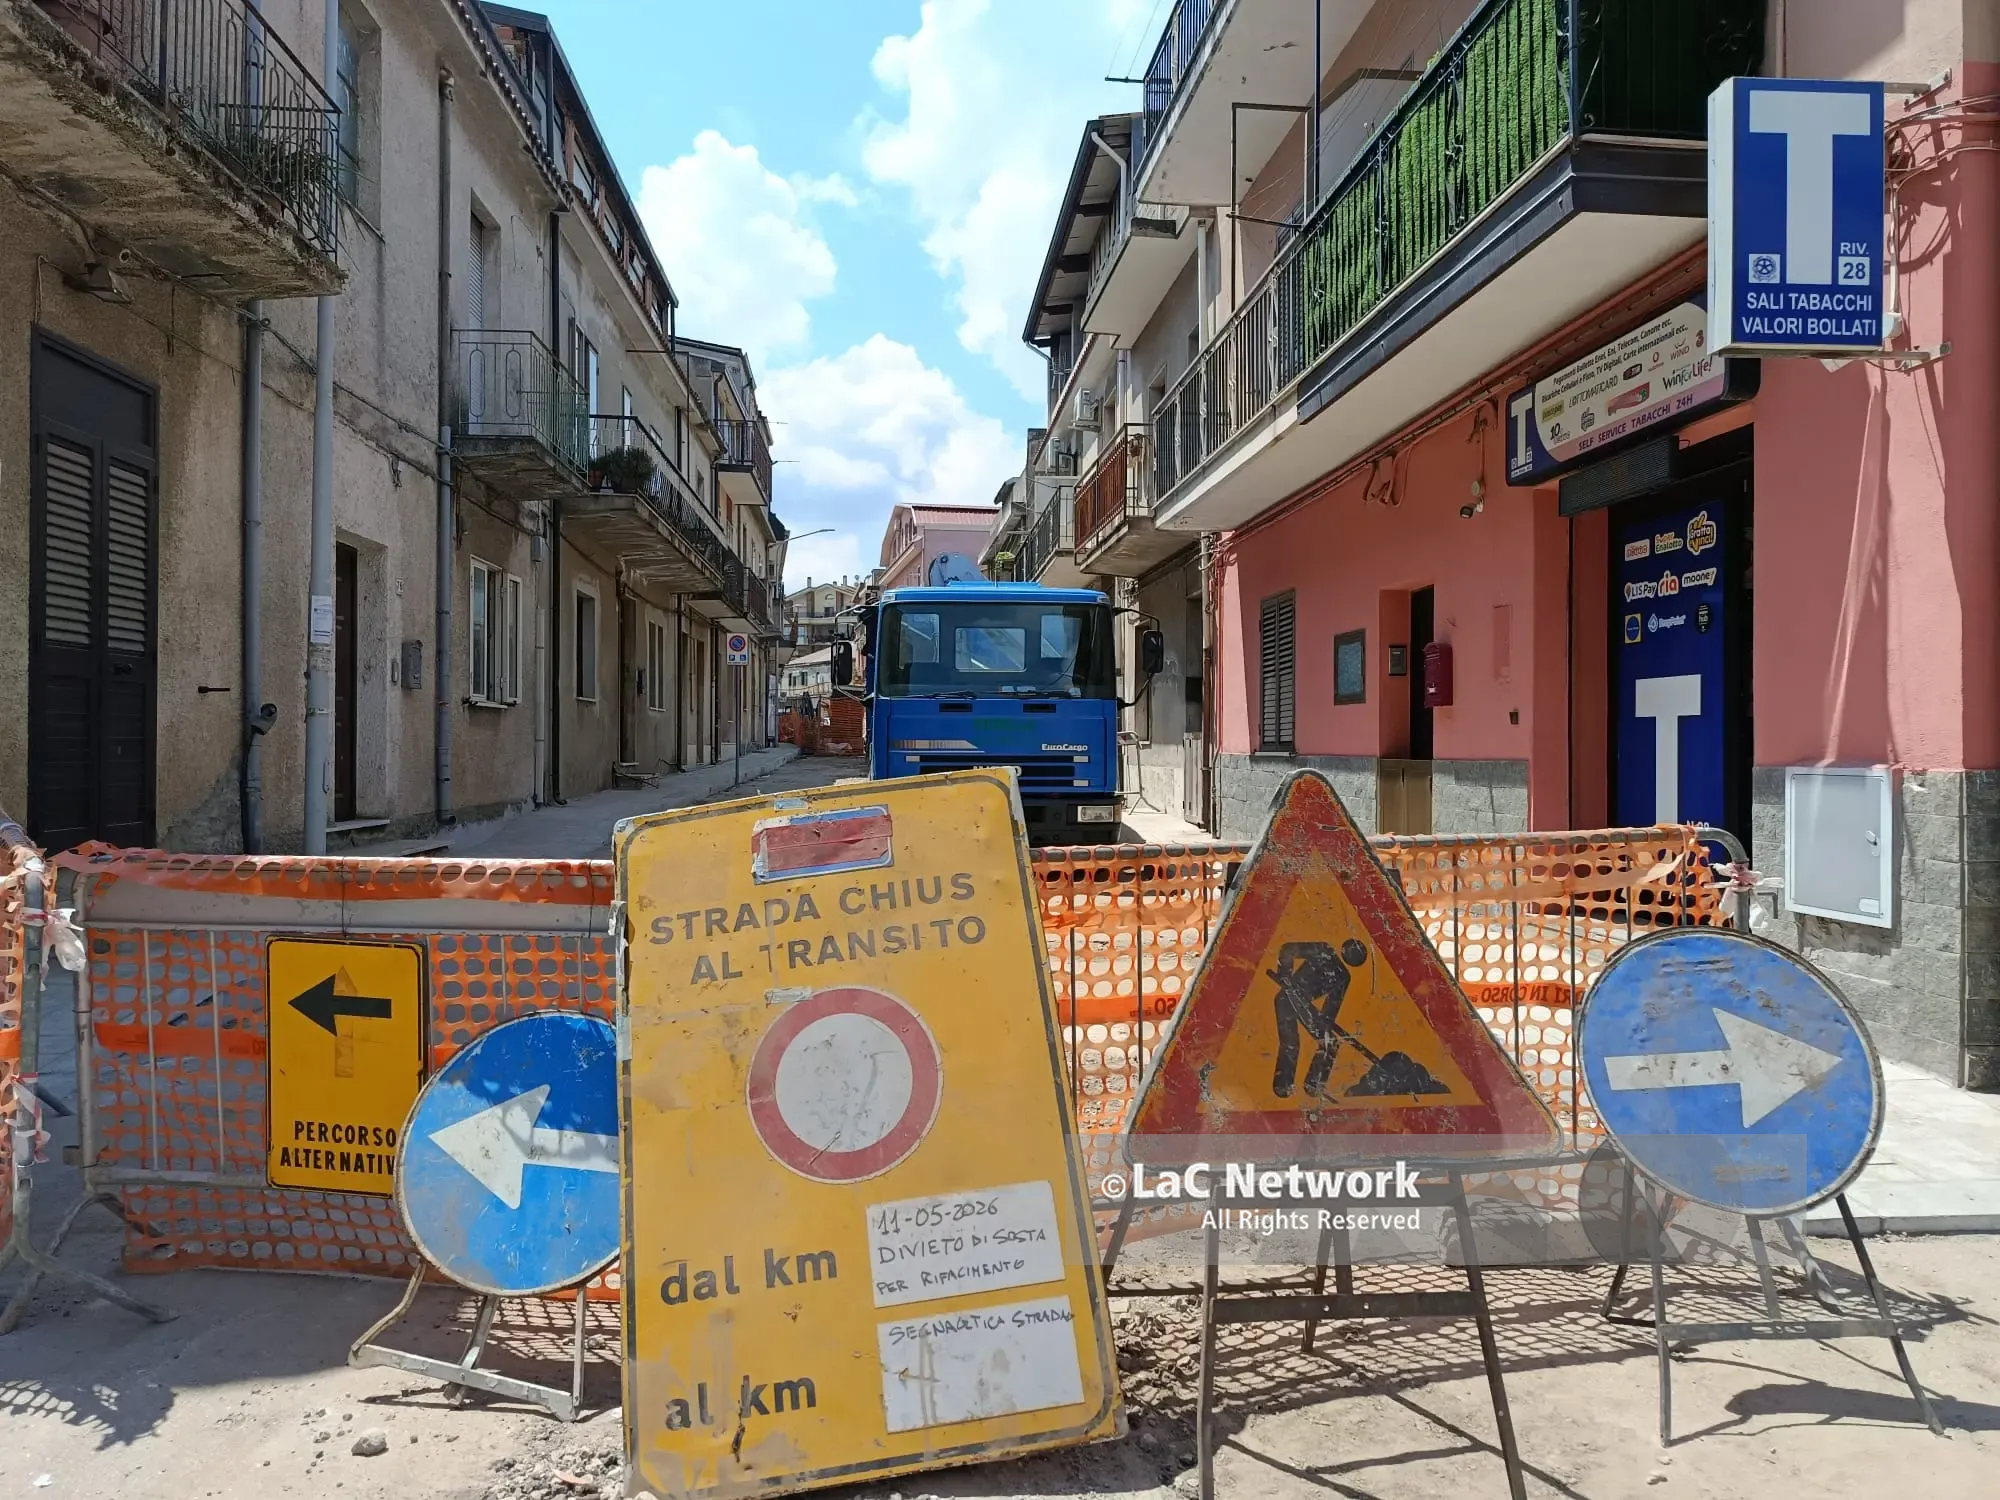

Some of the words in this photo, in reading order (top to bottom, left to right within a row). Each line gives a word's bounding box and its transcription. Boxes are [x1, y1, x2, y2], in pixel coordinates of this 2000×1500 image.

[1749, 90, 1871, 284] T
[1840, 242, 1869, 255] RIV.
[1843, 262, 1866, 280] 28
[1747, 292, 1784, 310] SALI
[1788, 293, 1872, 312] TABACCHI
[1640, 324, 1661, 340] Canone
[1742, 316, 1803, 334] VALORI
[1807, 318, 1876, 336] BOLLATI
[1596, 365, 1603, 375] TV
[1623, 347, 1637, 361] Carte
[1637, 327, 1675, 354] internazionali
[1670, 345, 1690, 361] WIND
[1511, 391, 1533, 467] T
[1578, 436, 1595, 451] SELF
[1598, 423, 1627, 443] SERVICE
[1630, 404, 1671, 429] TABACCHI
[1676, 393, 1693, 410] 24H
[1660, 572, 1678, 595] ria
[1684, 570, 1716, 585] mooney
[1041, 743, 1088, 752] EuroCargo
[1635, 674, 1702, 826] T
[649, 895, 821, 945] STRADA
[838, 872, 975, 915] CHIUS
[690, 955, 743, 985] AL
[759, 915, 986, 972] TRANSITO
[294, 1120, 397, 1147] PERCORSO
[878, 1197, 1000, 1236] 11-05-2026
[878, 1238, 965, 1265] DIVIETO
[972, 1234, 988, 1247] DI
[992, 1228, 1047, 1245] SOSTA
[660, 1256, 741, 1306] dal
[764, 1248, 837, 1289] km
[877, 1279, 909, 1295] PER
[920, 1258, 1026, 1286] RIFACIMENTO
[665, 1382, 714, 1431] al
[742, 1375, 817, 1419] km
